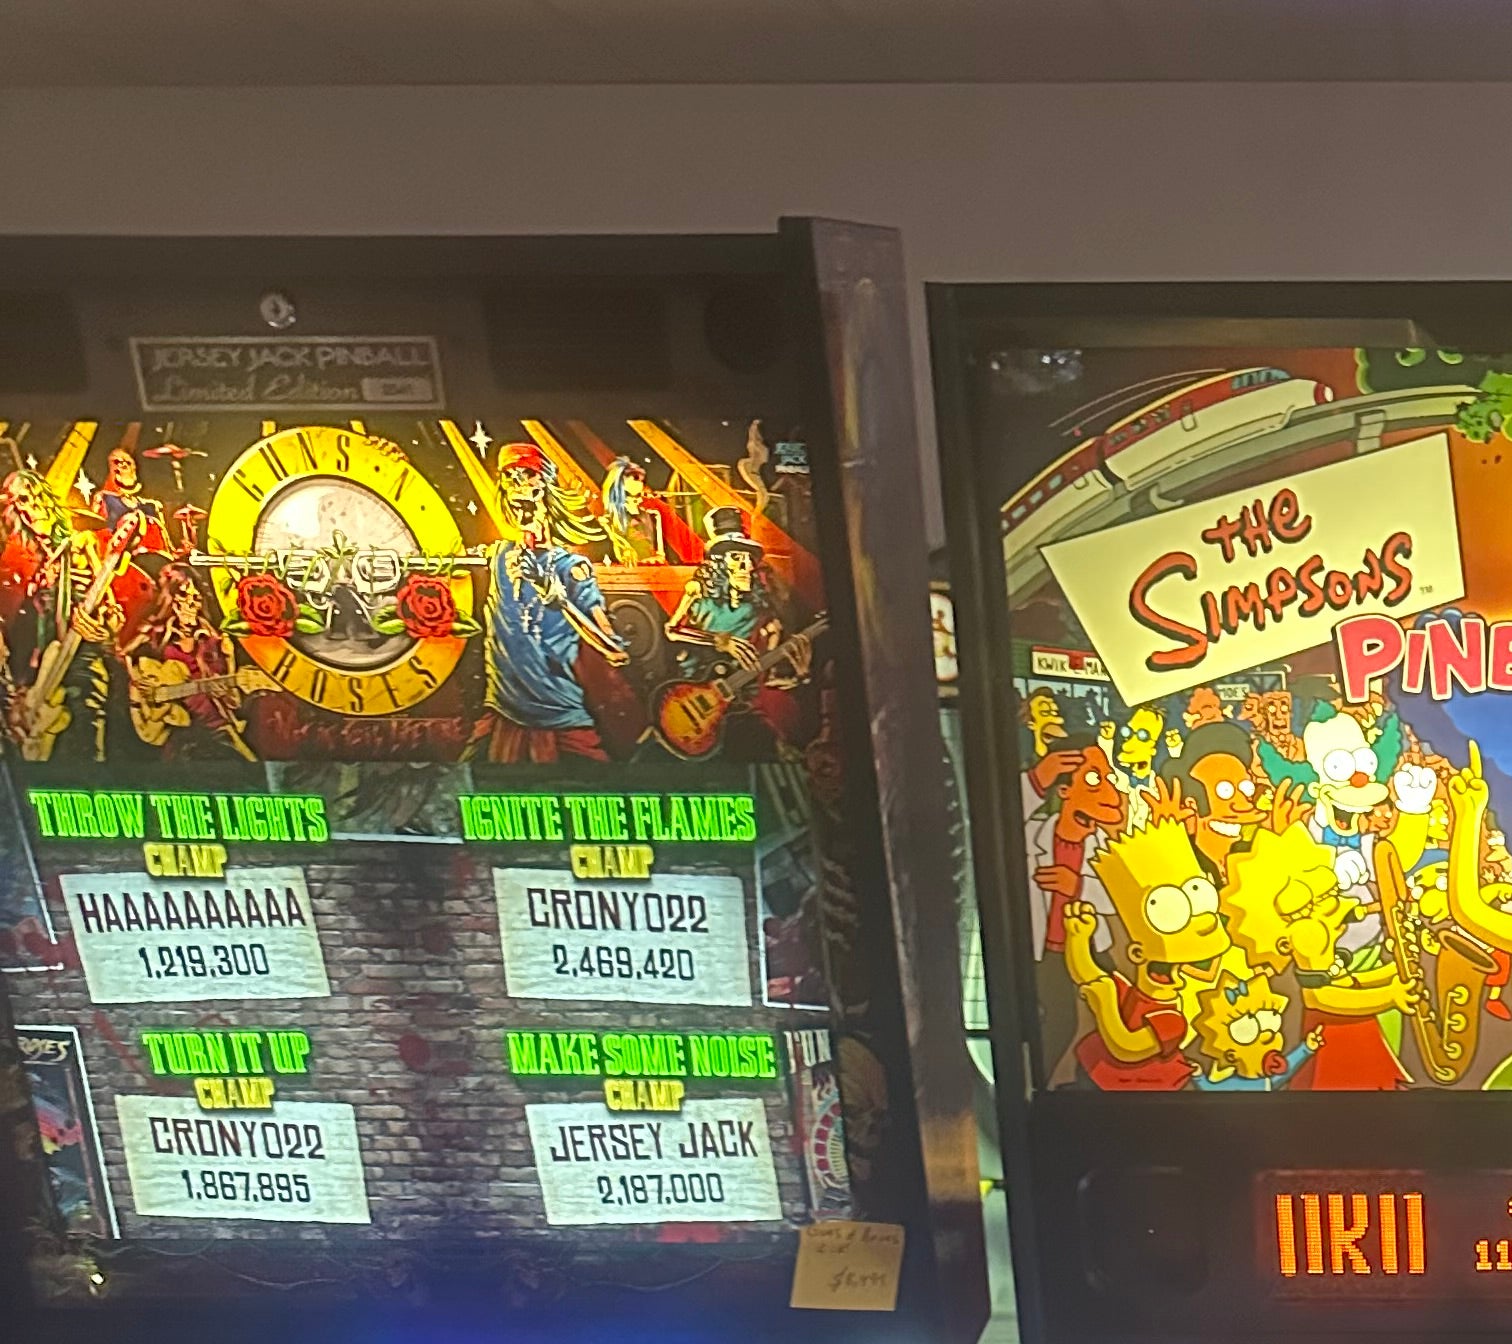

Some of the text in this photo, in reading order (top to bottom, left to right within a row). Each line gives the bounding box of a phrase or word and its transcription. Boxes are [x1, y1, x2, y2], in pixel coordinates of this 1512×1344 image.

[151, 347, 431, 371] JERSEY JACK PINBALL
[151, 374, 256, 402] Limited
[259, 374, 360, 402] Edition
[233, 431, 350, 502] GUNS
[272, 650, 438, 712] ROSES
[29, 791, 330, 843] THROW THE LIGHTS
[458, 794, 758, 843] IGNITE THE FLAMES
[142, 841, 229, 879] CHAMP
[569, 843, 655, 880] CHAMP
[141, 1030, 312, 1075] TURN IT UP
[506, 1032, 777, 1079] MAKE SOME NOISE
[193, 1077, 276, 1111] CHAMP
[603, 1078, 686, 1112] CHAMP
[550, 1119, 759, 1163] JERSEY JACK
